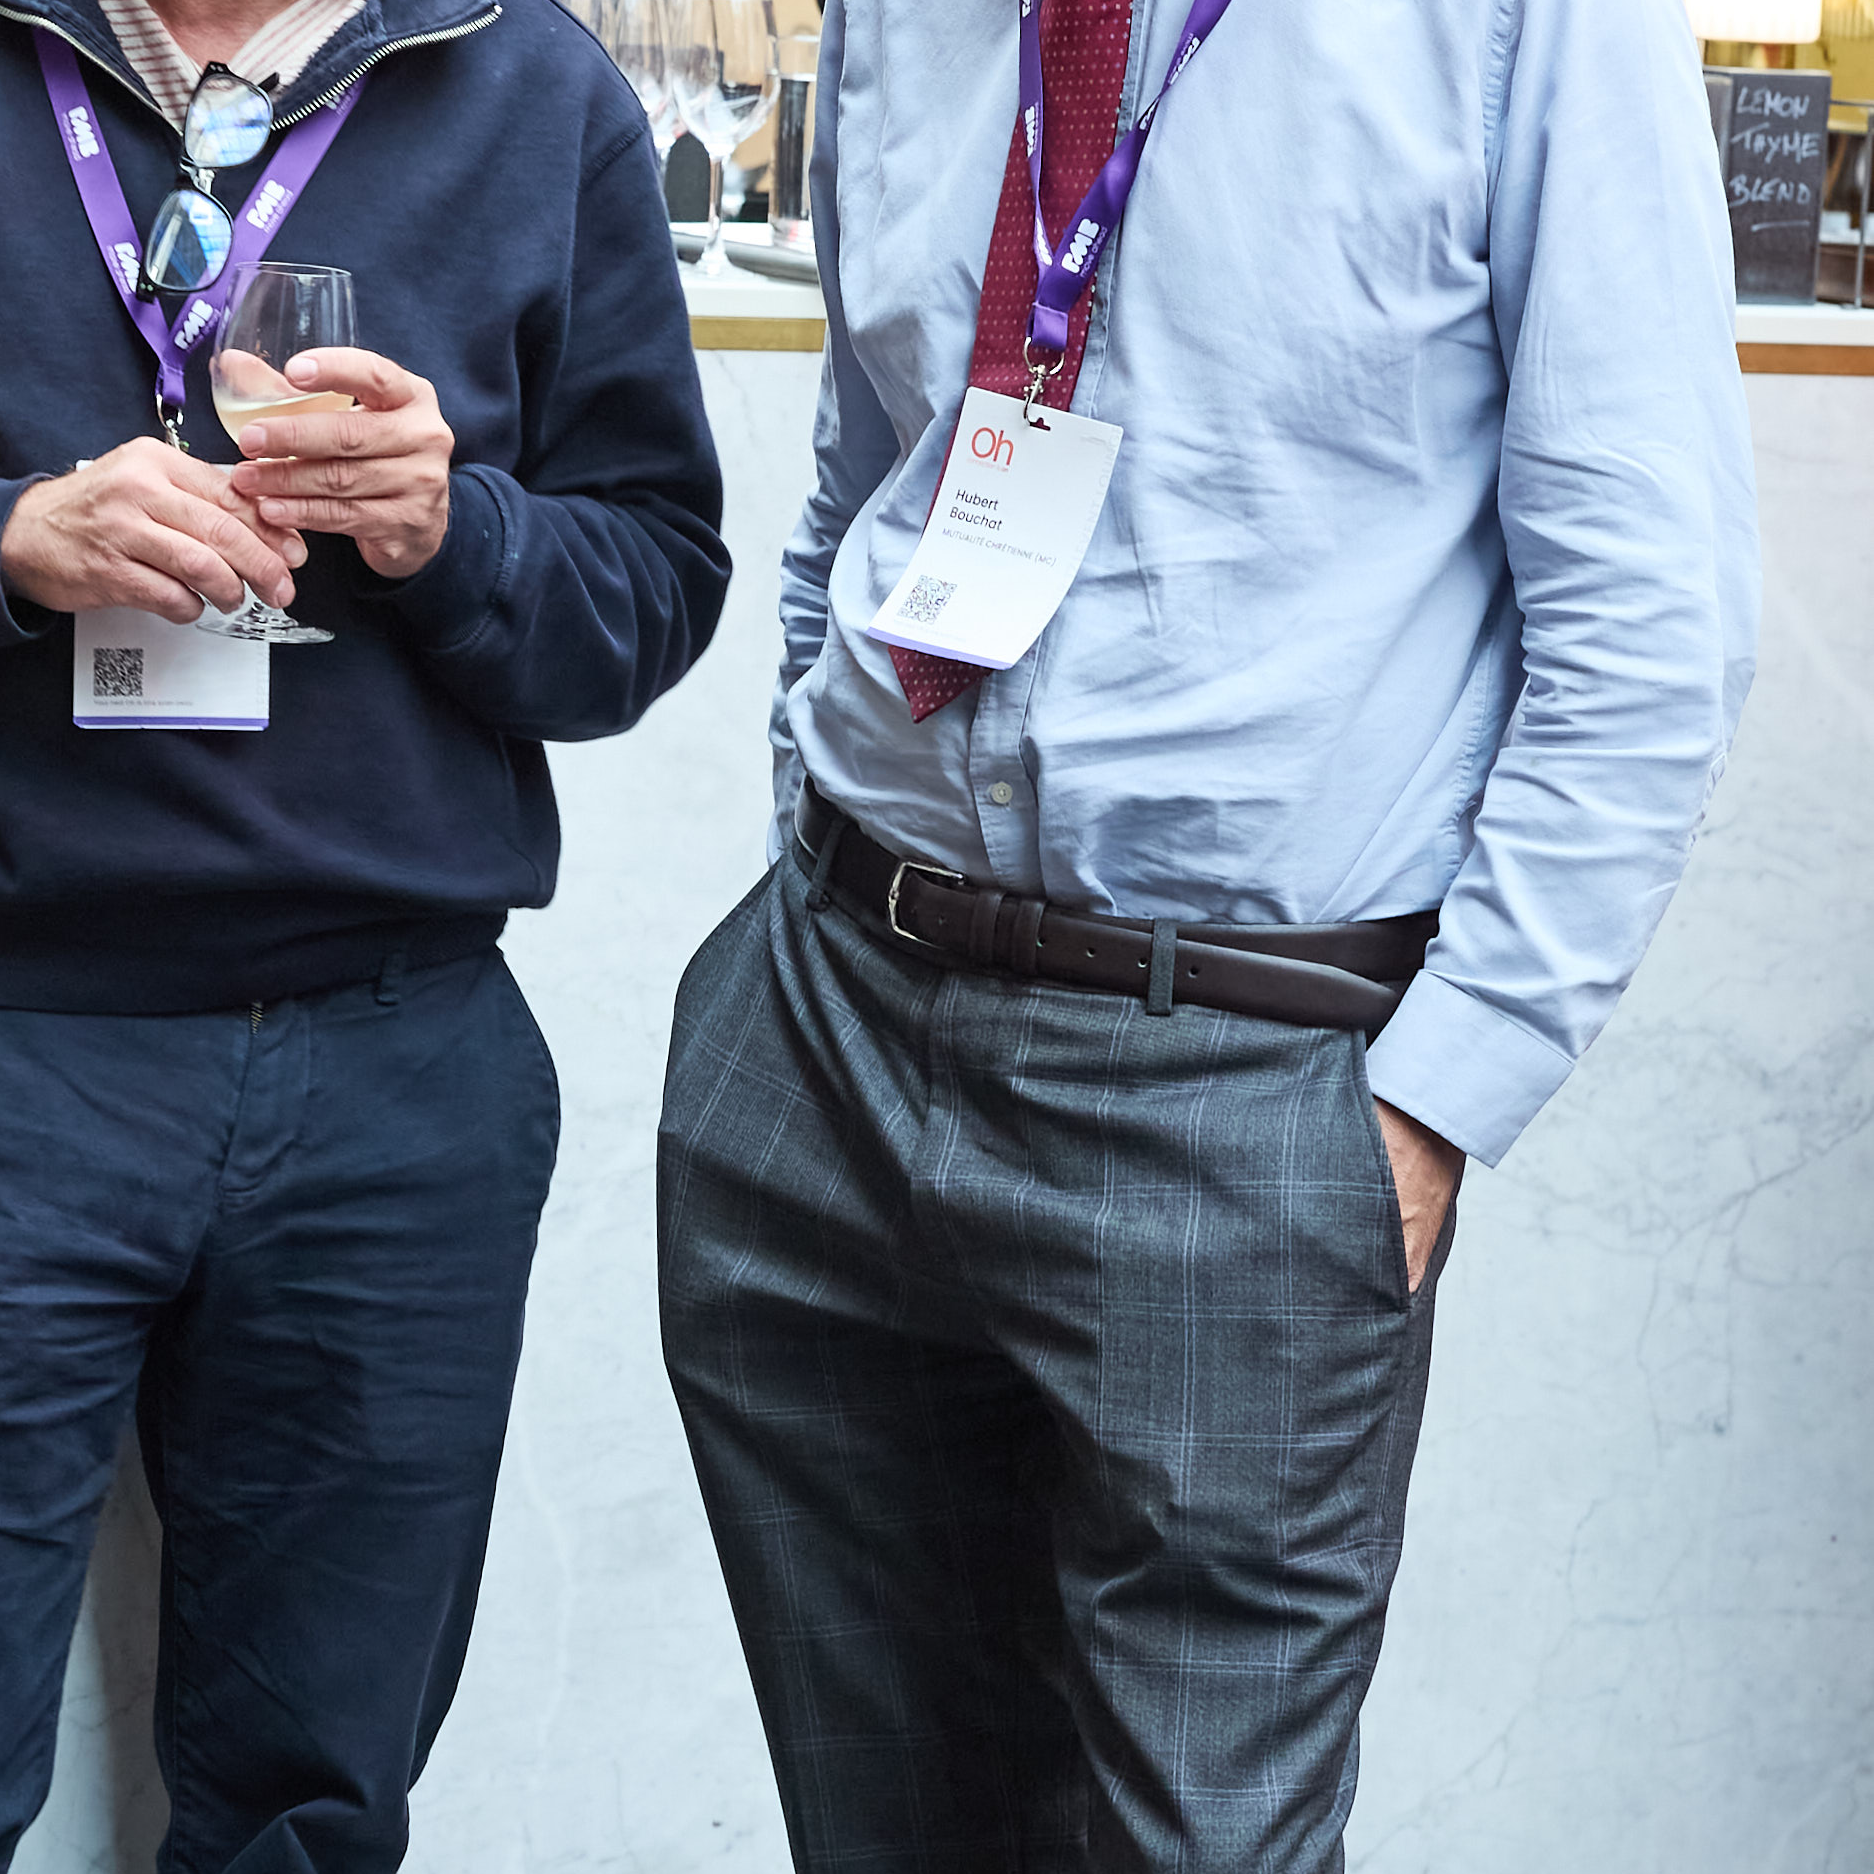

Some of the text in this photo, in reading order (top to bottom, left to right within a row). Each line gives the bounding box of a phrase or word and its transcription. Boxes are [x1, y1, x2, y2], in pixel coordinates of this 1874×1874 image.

[1735, 86, 1811, 120] LEMON
[1728, 174, 1811, 207] BLEND
[971, 427, 1014, 466] Oh
[955, 489, 999, 511] Hubert
[949, 506, 1003, 531] Bouchat
